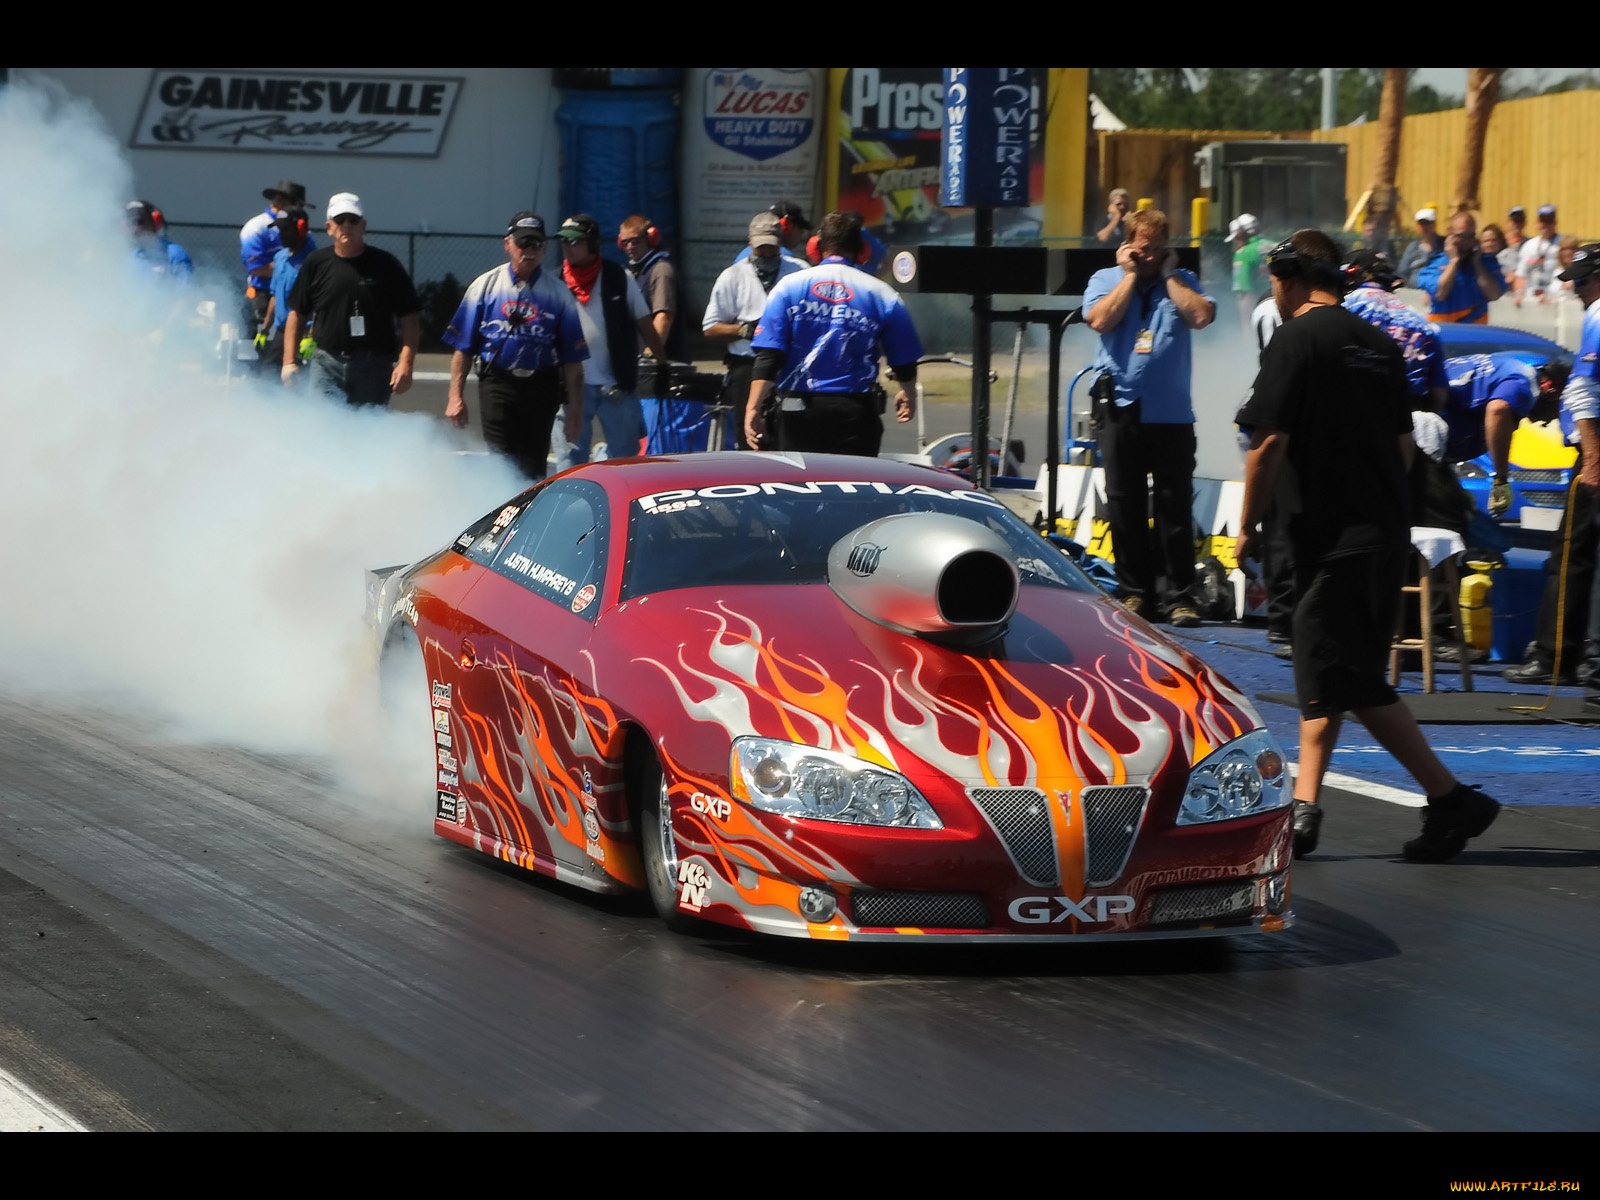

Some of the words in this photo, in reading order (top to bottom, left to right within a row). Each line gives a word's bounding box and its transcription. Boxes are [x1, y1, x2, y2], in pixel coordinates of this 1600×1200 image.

[159, 75, 446, 116] GAINESVILLE
[715, 90, 811, 114] LUCAS
[851, 68, 943, 130] Pres
[198, 114, 433, 149] Raceway
[714, 120, 766, 134] HEAVY
[768, 120, 807, 134] DUTY
[993, 68, 1030, 201] POWERADE
[637, 481, 1005, 510] PONTIAC
[503, 551, 533, 575] JUSTIN
[526, 562, 577, 596] HUMPHREYS
[690, 791, 732, 819] GXP
[1007, 895, 1136, 924] GXP
